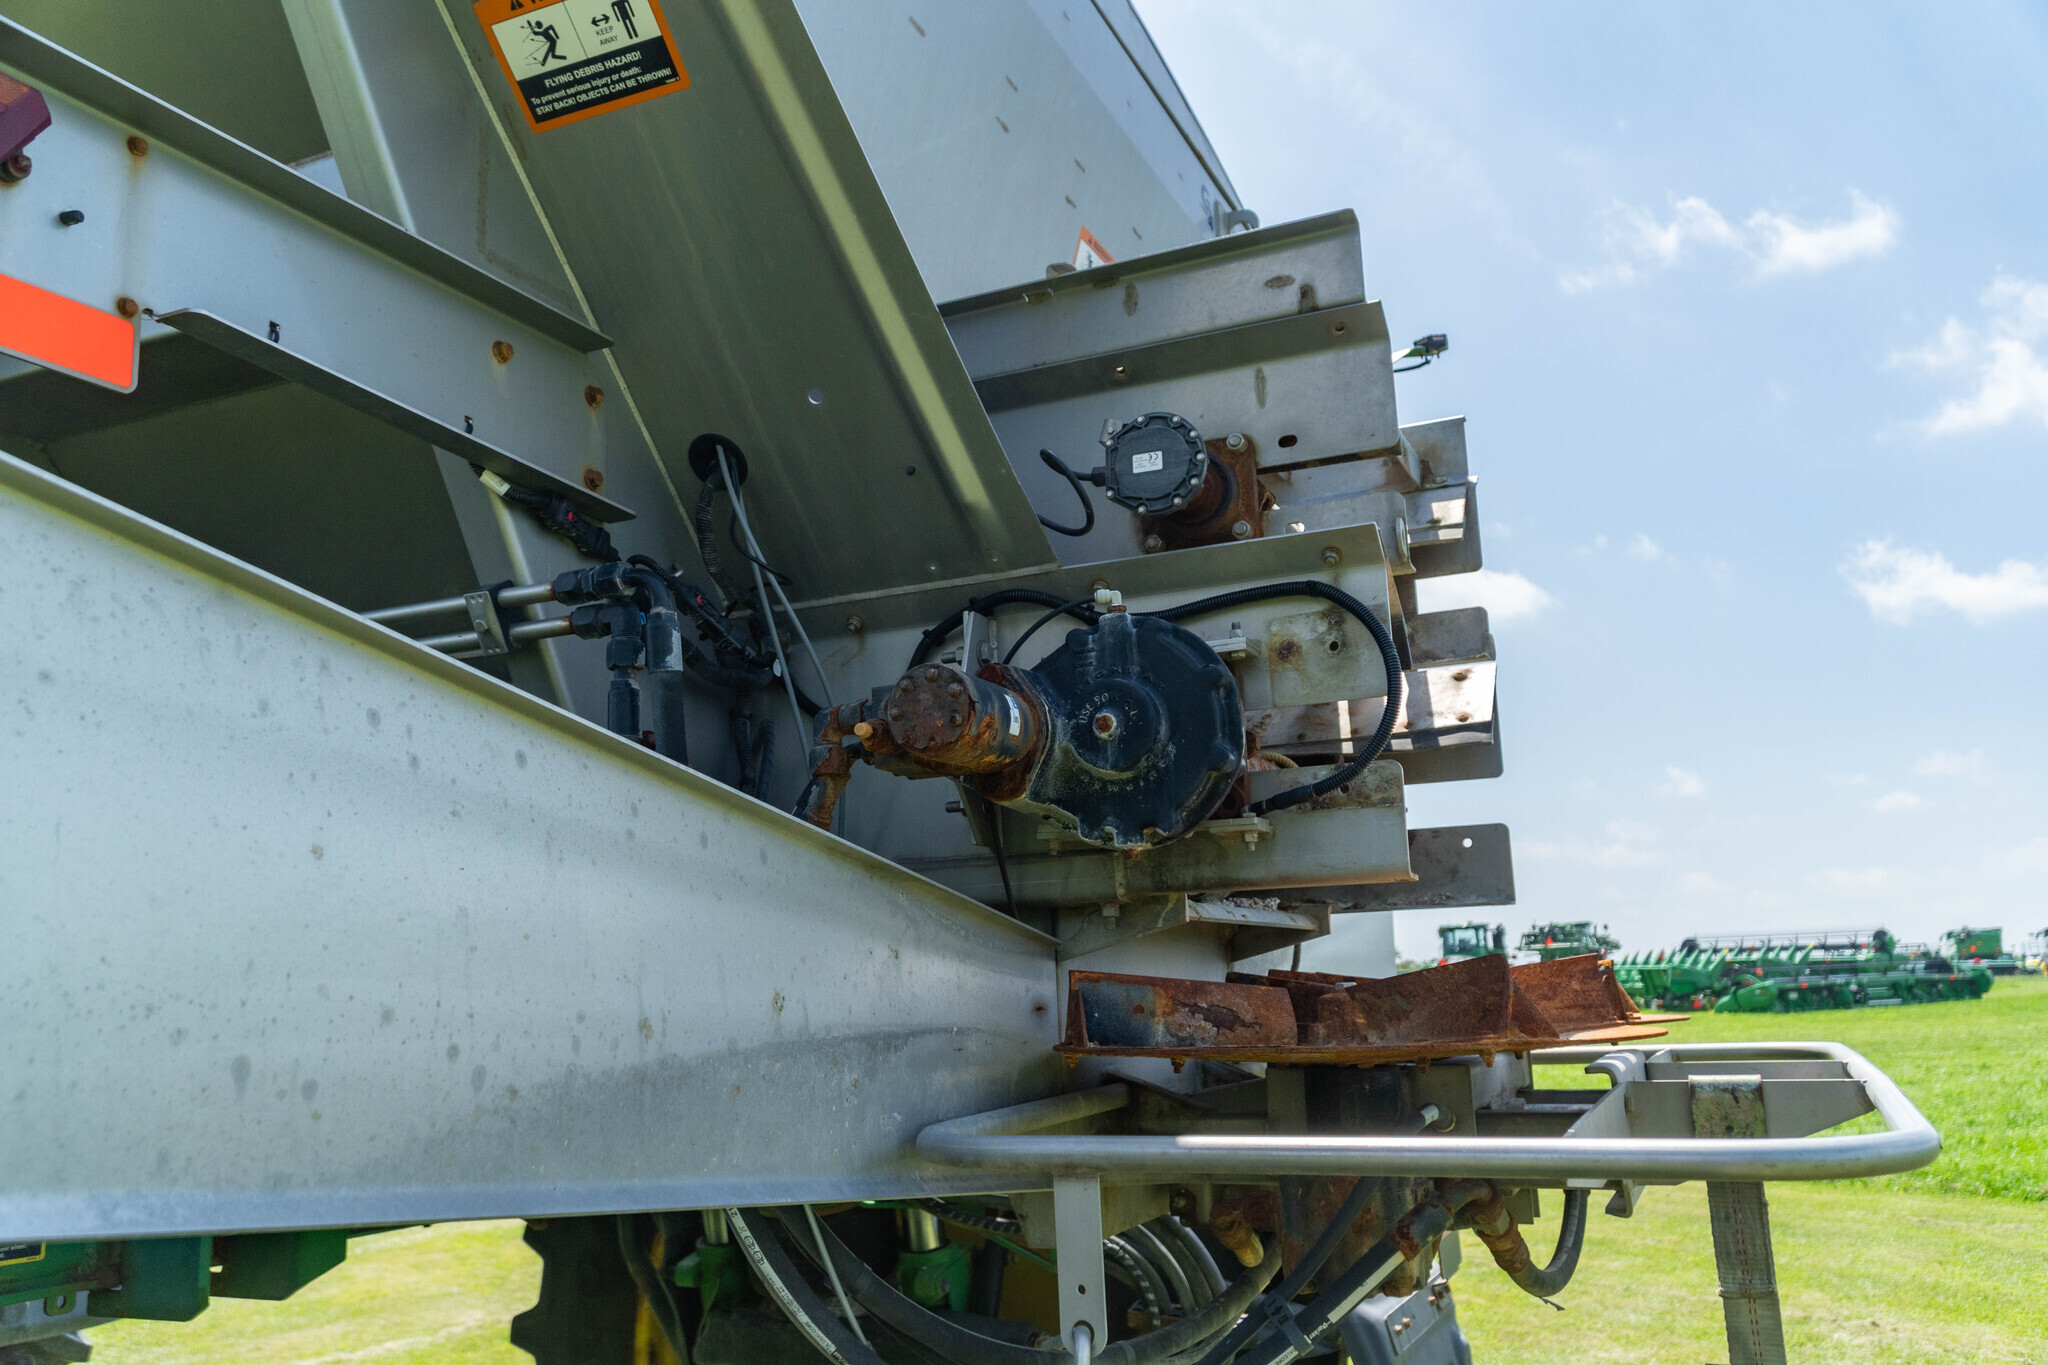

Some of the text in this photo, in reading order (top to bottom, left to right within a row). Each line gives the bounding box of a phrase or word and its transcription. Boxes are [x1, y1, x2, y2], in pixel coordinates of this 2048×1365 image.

[596, 25, 614, 36] KEEP
[600, 34, 618, 46] AWAY
[544, 50, 642, 88] FLYING DEBRIS HAZARD!
[531, 97, 541, 105] To
[541, 90, 566, 104] prevent
[566, 82, 592, 95] serious
[590, 76, 612, 88] injury
[620, 66, 642, 78] death:
[536, 104, 554, 116] STAY
[554, 96, 578, 110] BACK!
[576, 86, 610, 103] OBJECTS
[610, 81, 626, 92] CAN
[627, 78, 638, 88] BE
[638, 67, 672, 84] THROWN!
[1079, 702, 1095, 724] USE
